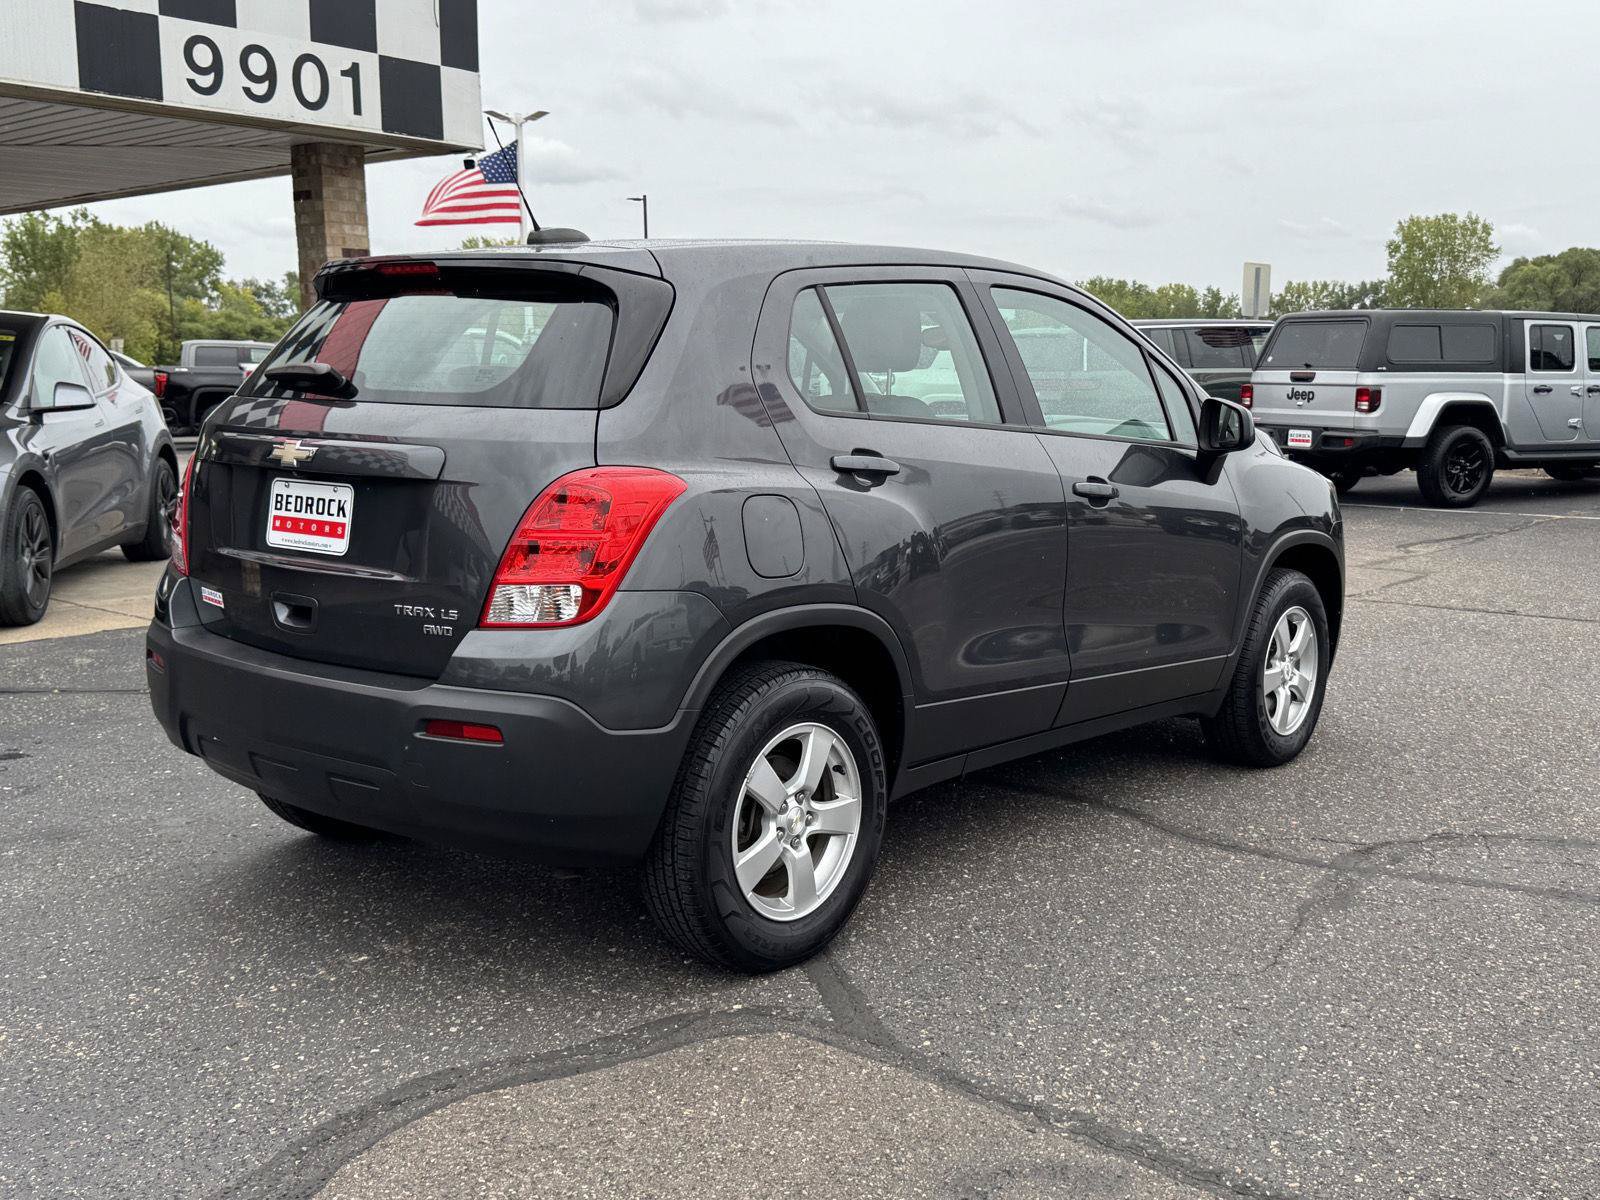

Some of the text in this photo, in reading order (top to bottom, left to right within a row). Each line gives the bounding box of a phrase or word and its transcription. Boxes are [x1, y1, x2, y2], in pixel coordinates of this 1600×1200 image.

[183, 34, 362, 116] 9901
[1286, 387, 1315, 403] Jeep
[274, 493, 347, 518] BEDROCK
[274, 519, 343, 535] MOTORS
[394, 604, 459, 621] TRAX LS
[423, 623, 453, 637] AWD
[855, 717, 886, 832] COOPER
